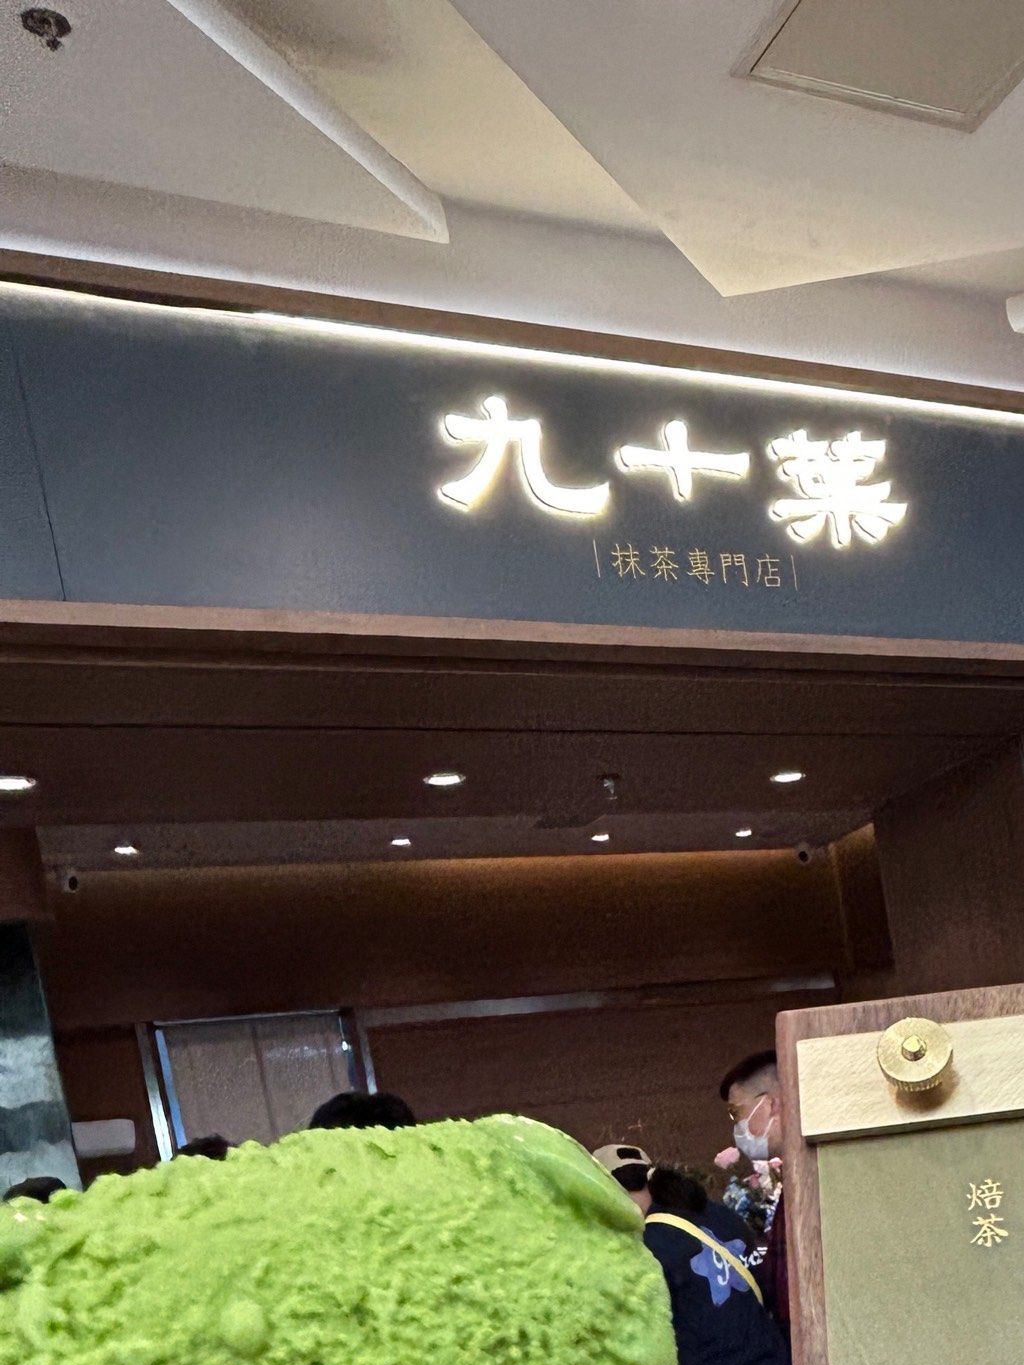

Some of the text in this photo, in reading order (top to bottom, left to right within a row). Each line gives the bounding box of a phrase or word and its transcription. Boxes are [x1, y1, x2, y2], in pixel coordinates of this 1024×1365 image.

[611, 543, 782, 589] 抹茶專門店
[966, 1179, 1009, 1248] 焙茶
